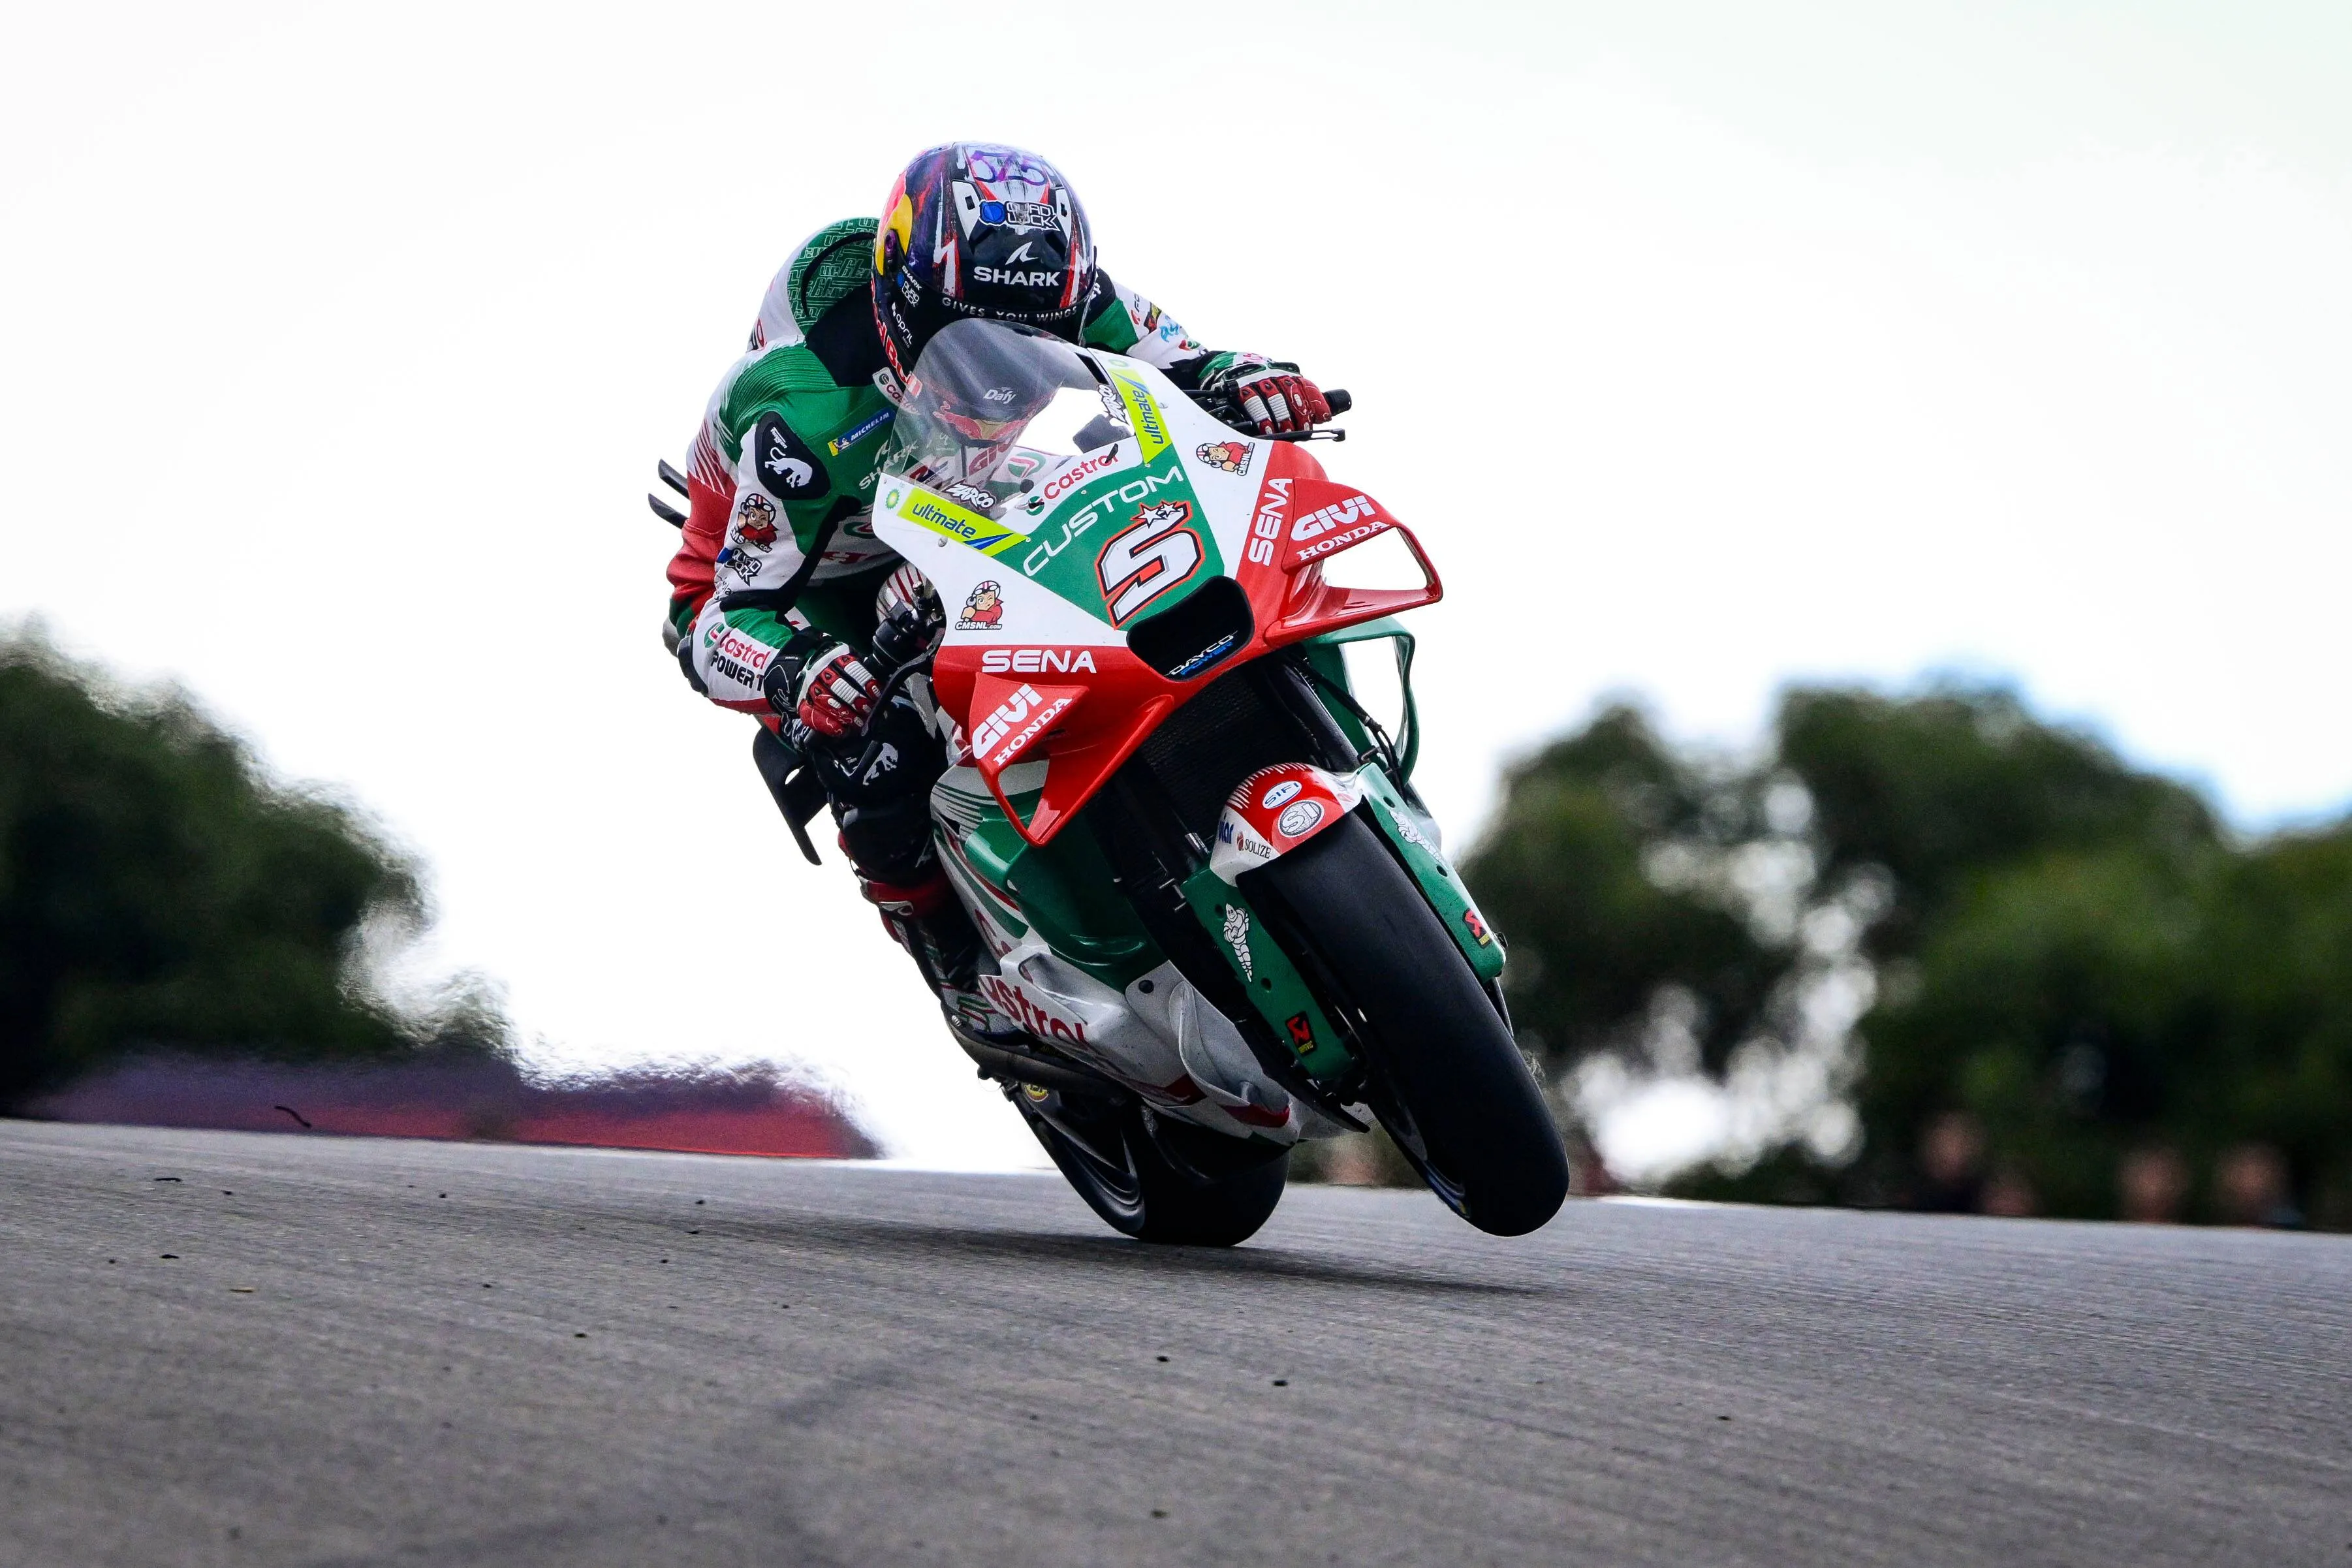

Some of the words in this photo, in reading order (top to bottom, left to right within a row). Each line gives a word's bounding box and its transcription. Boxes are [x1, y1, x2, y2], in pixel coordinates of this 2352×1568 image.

[902, 265, 922, 290] SHARK
[973, 266, 1061, 287] SHARK
[942, 297, 985, 317] GIVES
[996, 311, 1027, 322] YOU
[1036, 306, 1077, 322] WINGS
[983, 389, 1016, 404] Dafy
[851, 412, 890, 441] MICHELIN
[1132, 390, 1164, 445] ultimate
[945, 482, 996, 509] ZARCO
[912, 503, 976, 539] ultimate
[1023, 466, 1184, 576] CUSTOM
[1248, 478, 1293, 566] SENA
[1291, 496, 1375, 541] GIVI
[1296, 522, 1390, 561] HONDA
[1095, 501, 1206, 630] 5
[982, 650, 1097, 674] SENA
[1169, 635, 1234, 675] DAYCO
[972, 683, 1043, 760] GIVI
[993, 698, 1073, 766] HONDA
[1245, 839, 1271, 859] SOLIZE
